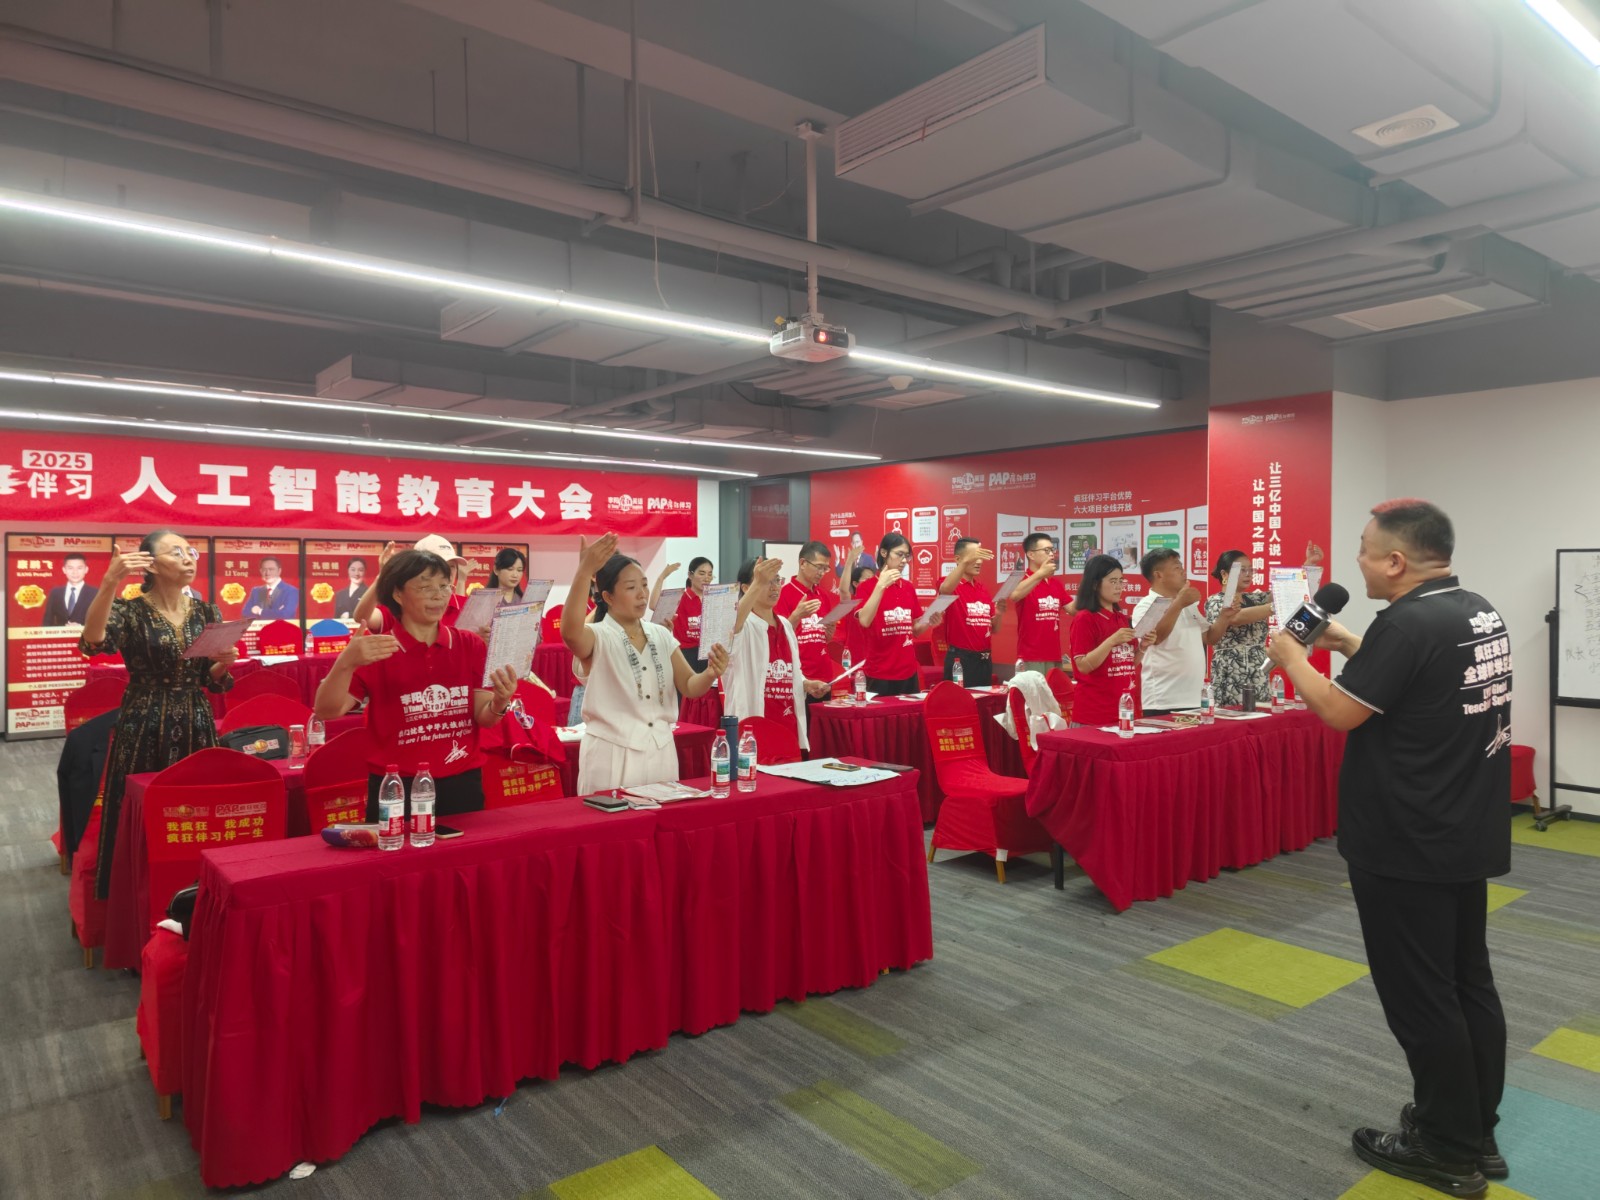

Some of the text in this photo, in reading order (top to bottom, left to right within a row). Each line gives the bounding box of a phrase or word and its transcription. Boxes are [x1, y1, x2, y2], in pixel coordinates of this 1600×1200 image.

[29, 452, 86, 469] 2025
[27, 472, 92, 499] 伴习
[120, 456, 594, 520] 人工智能教育大会
[1074, 491, 1132, 503] 疯狂伴习平台优势
[1074, 503, 1132, 514] 六大项目全线开放
[1252, 479, 1265, 593] 让中国之声响彻
[166, 817, 264, 832] 我疯狂 我成功
[166, 828, 264, 843] 疯狂伴习伴一生
